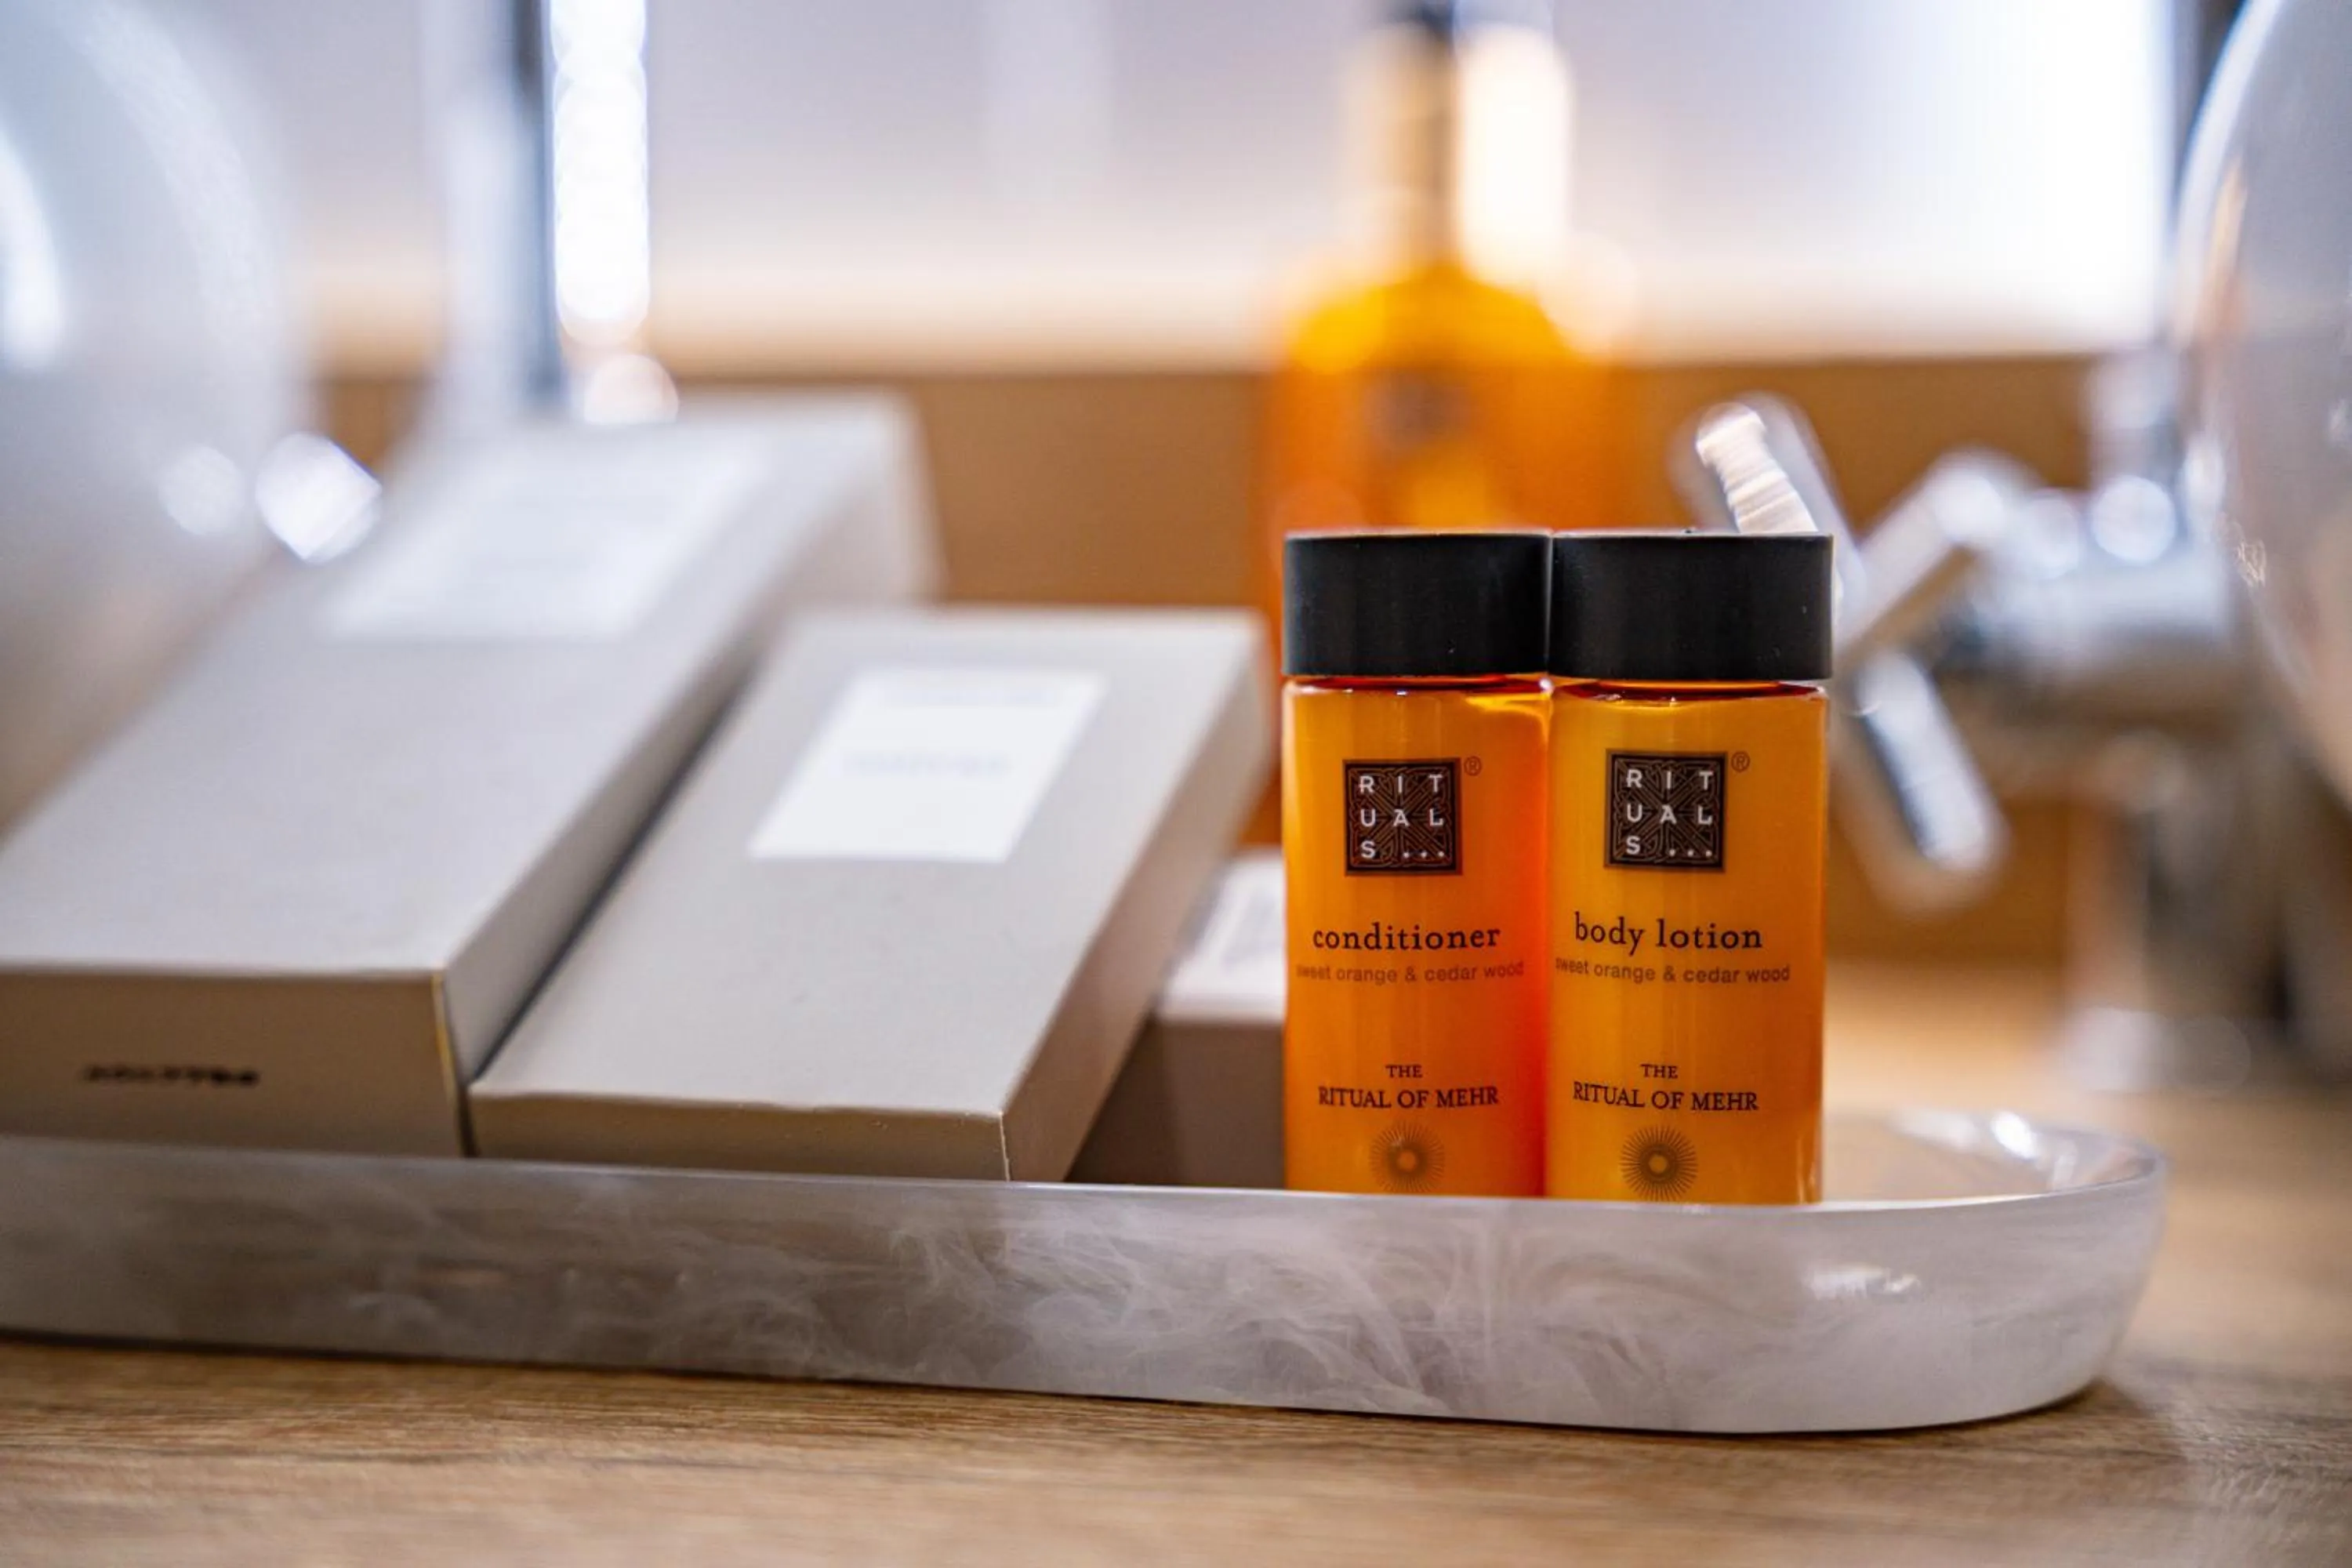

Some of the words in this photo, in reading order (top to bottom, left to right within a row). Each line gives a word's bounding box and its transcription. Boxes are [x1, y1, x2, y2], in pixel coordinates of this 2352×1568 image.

[1312, 921, 1501, 950] conditioner
[1574, 911, 1645, 956] body
[1656, 919, 1762, 949] lotion
[1336, 967, 1398, 985] orange
[1404, 965, 1417, 982] &
[1424, 964, 1477, 982] cedar
[1483, 960, 1524, 978] wood
[1555, 956, 1589, 975] sweet
[1594, 962, 1656, 984] orange
[1663, 965, 1677, 982] &
[1682, 965, 1740, 984] cedar
[1745, 965, 1791, 982] wood
[1385, 1064, 1423, 1079] THE
[1641, 1063, 1679, 1080] THE
[1319, 1086, 1392, 1109] RITUAL
[1397, 1090, 1430, 1109] OF
[1436, 1085, 1499, 1109] MEHR
[1573, 1080, 1646, 1108] RITUAL
[1651, 1091, 1685, 1109] OF
[1691, 1091, 1759, 1112] MEHR
